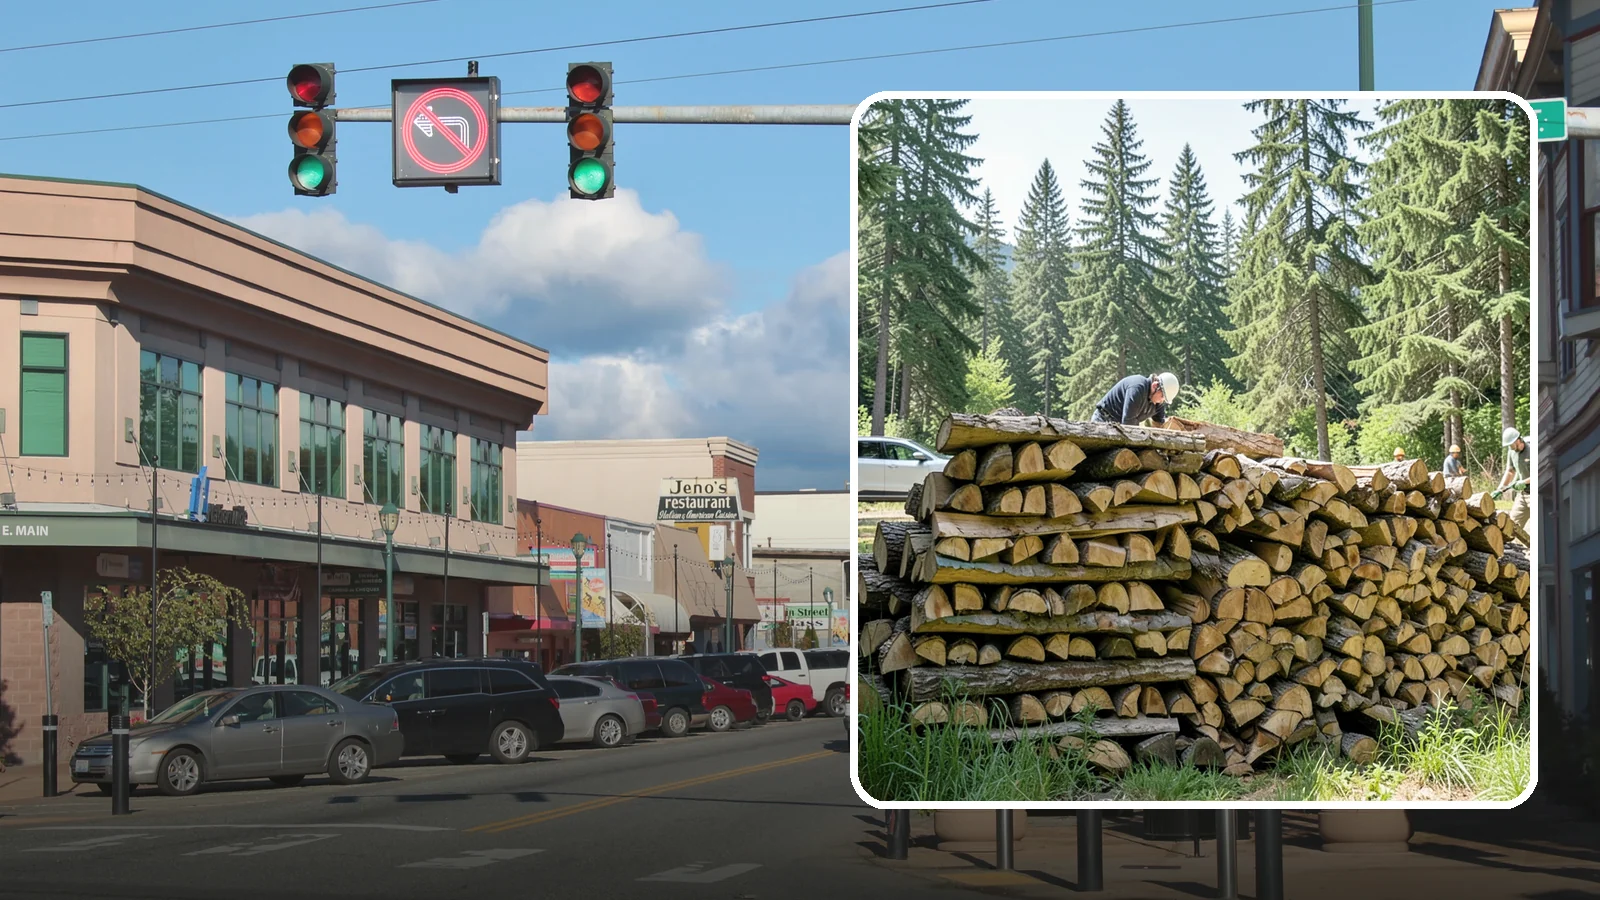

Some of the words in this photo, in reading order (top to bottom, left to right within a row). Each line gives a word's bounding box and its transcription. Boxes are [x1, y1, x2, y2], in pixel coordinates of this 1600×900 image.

[670, 480, 727, 495] Jeno's
[665, 496, 731, 509] restaurant
[659, 510, 682, 519] Italian
[686, 509, 715, 519] American
[715, 509, 738, 519] Cuisine
[2, 525, 13, 536] E.
[15, 525, 49, 536] MAIN
[797, 608, 828, 616] Street
